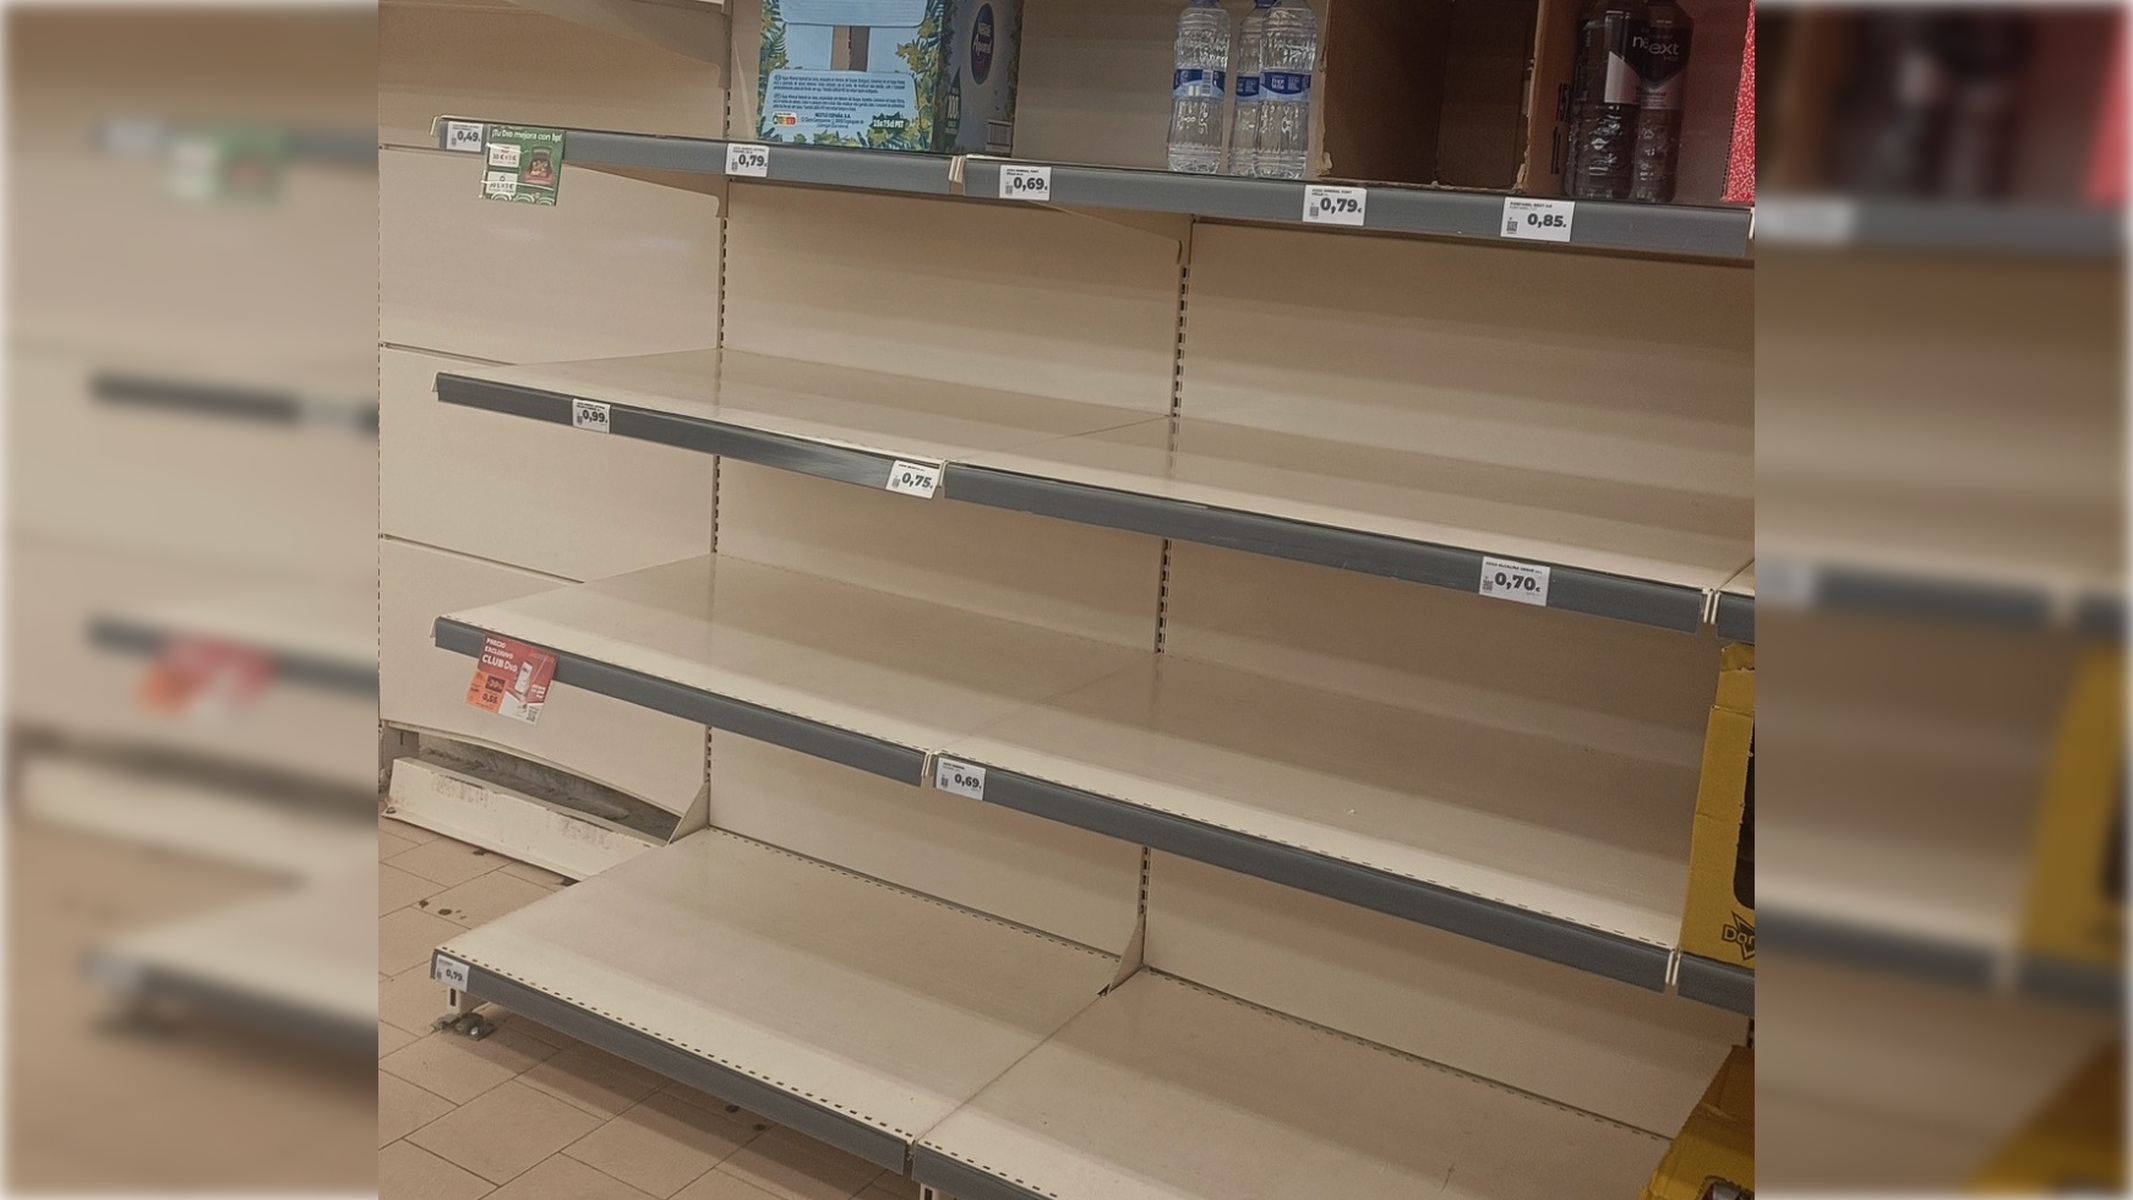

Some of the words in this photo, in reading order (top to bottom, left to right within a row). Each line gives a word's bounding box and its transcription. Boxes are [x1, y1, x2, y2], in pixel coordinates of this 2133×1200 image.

[514, 130, 537, 141] mejora
[537, 133, 551, 141] con
[486, 637, 507, 649] PRECIO
[482, 653, 505, 668] CLUB
